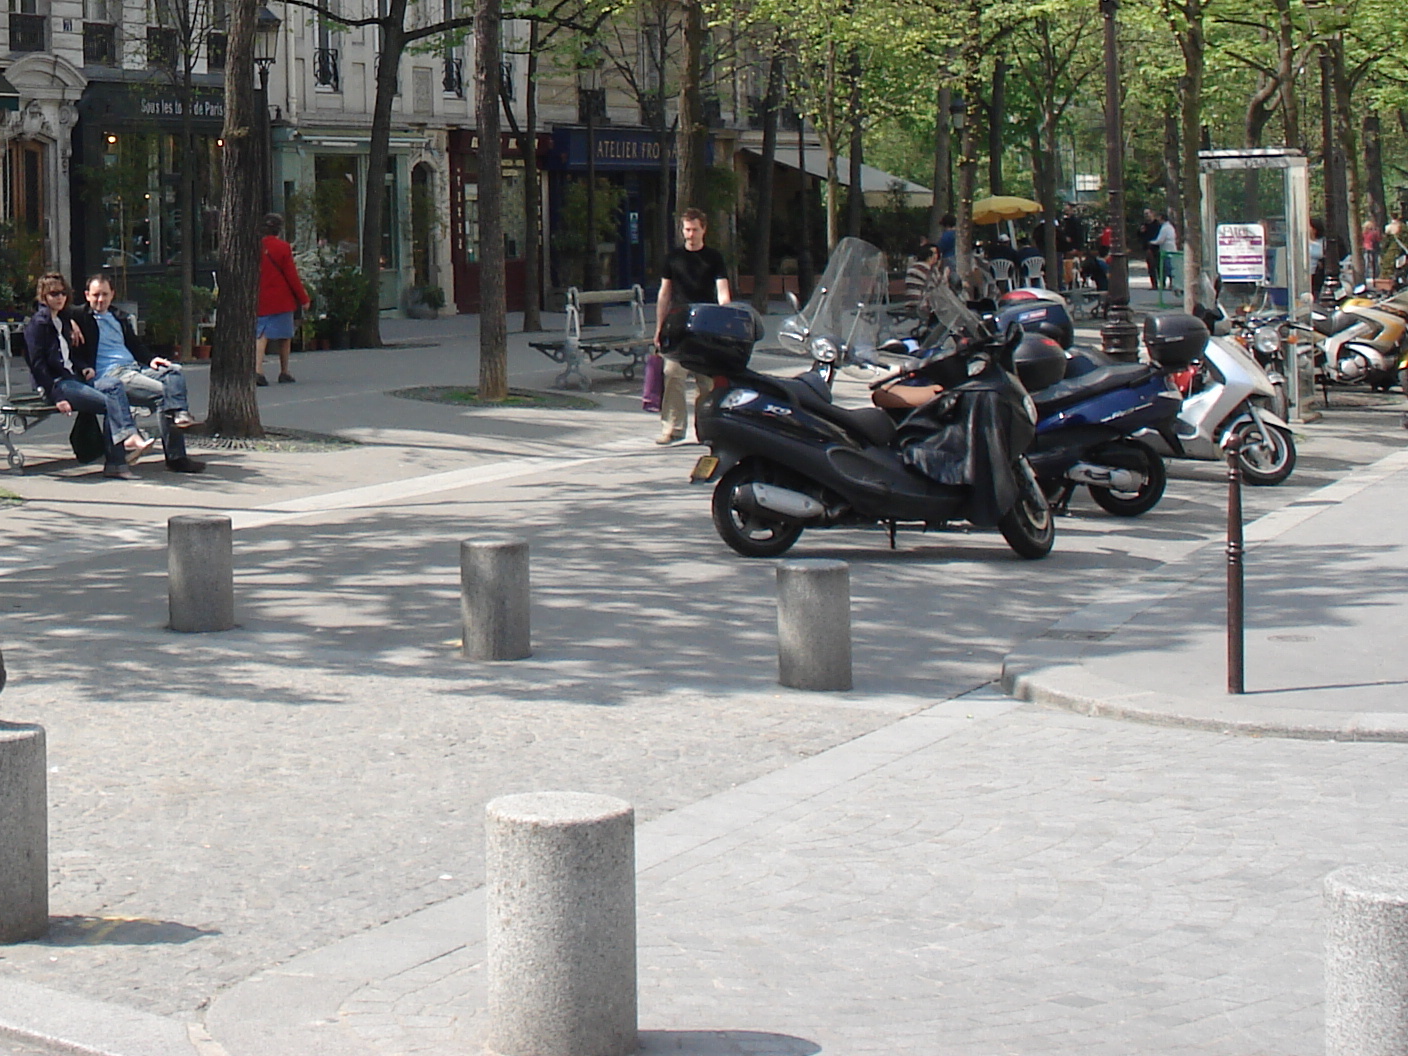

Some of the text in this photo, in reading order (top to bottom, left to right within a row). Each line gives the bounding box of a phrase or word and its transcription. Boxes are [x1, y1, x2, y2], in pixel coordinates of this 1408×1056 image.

[141, 98, 159, 114] Sous
[162, 99, 173, 114] les
[194, 101, 203, 115] de
[205, 101, 223, 116] Paris
[597, 141, 637, 158] ATELIER
